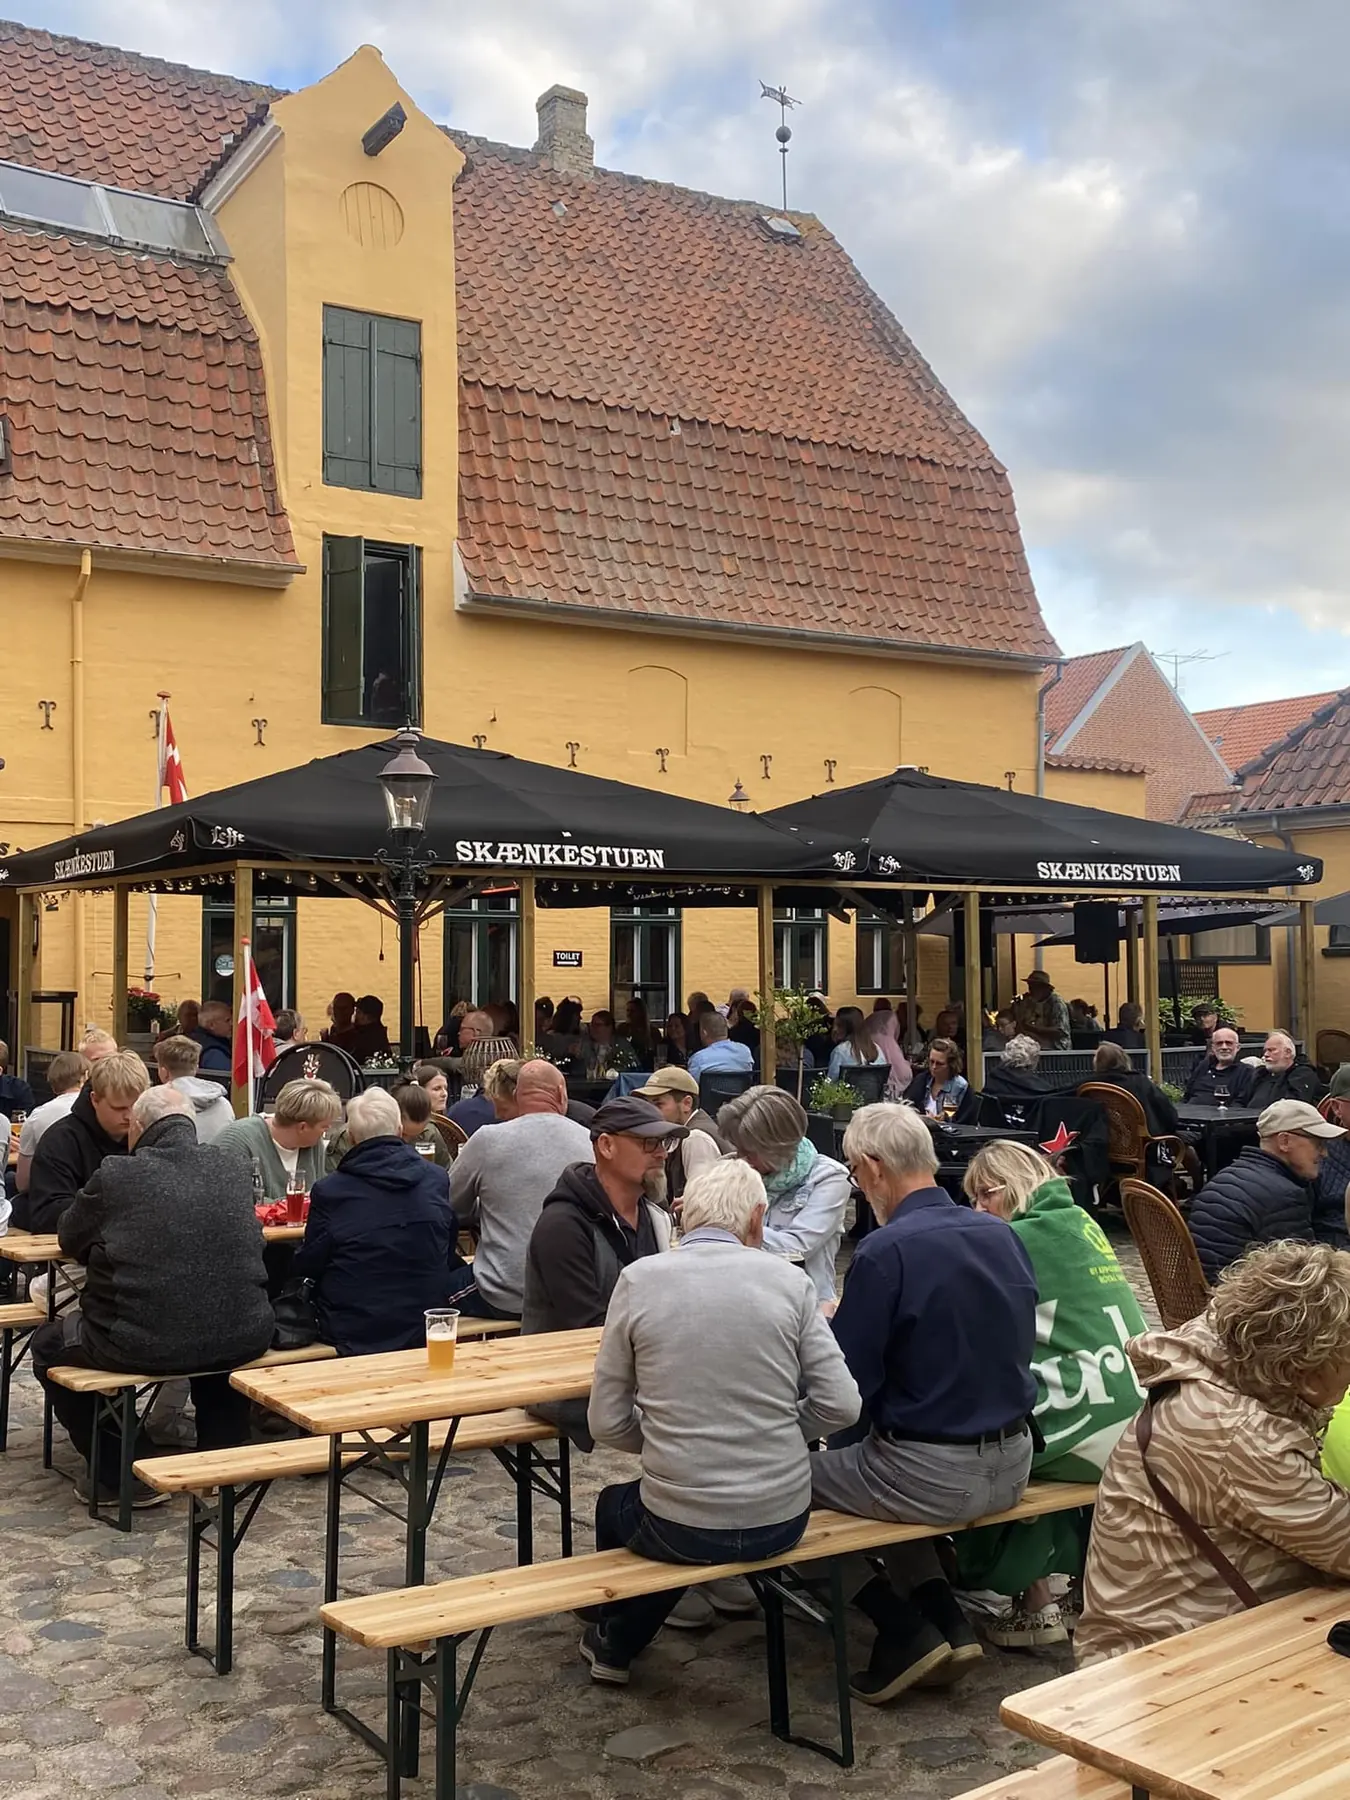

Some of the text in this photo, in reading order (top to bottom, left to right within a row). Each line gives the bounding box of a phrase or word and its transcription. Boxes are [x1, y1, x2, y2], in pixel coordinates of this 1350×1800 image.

[54, 849, 115, 880] SKÆNKESTUEN
[455, 840, 665, 869] SKÆNKESTUEN
[1036, 861, 1181, 882] SKÆNKESTUEN
[555, 952, 580, 961] TOILET
